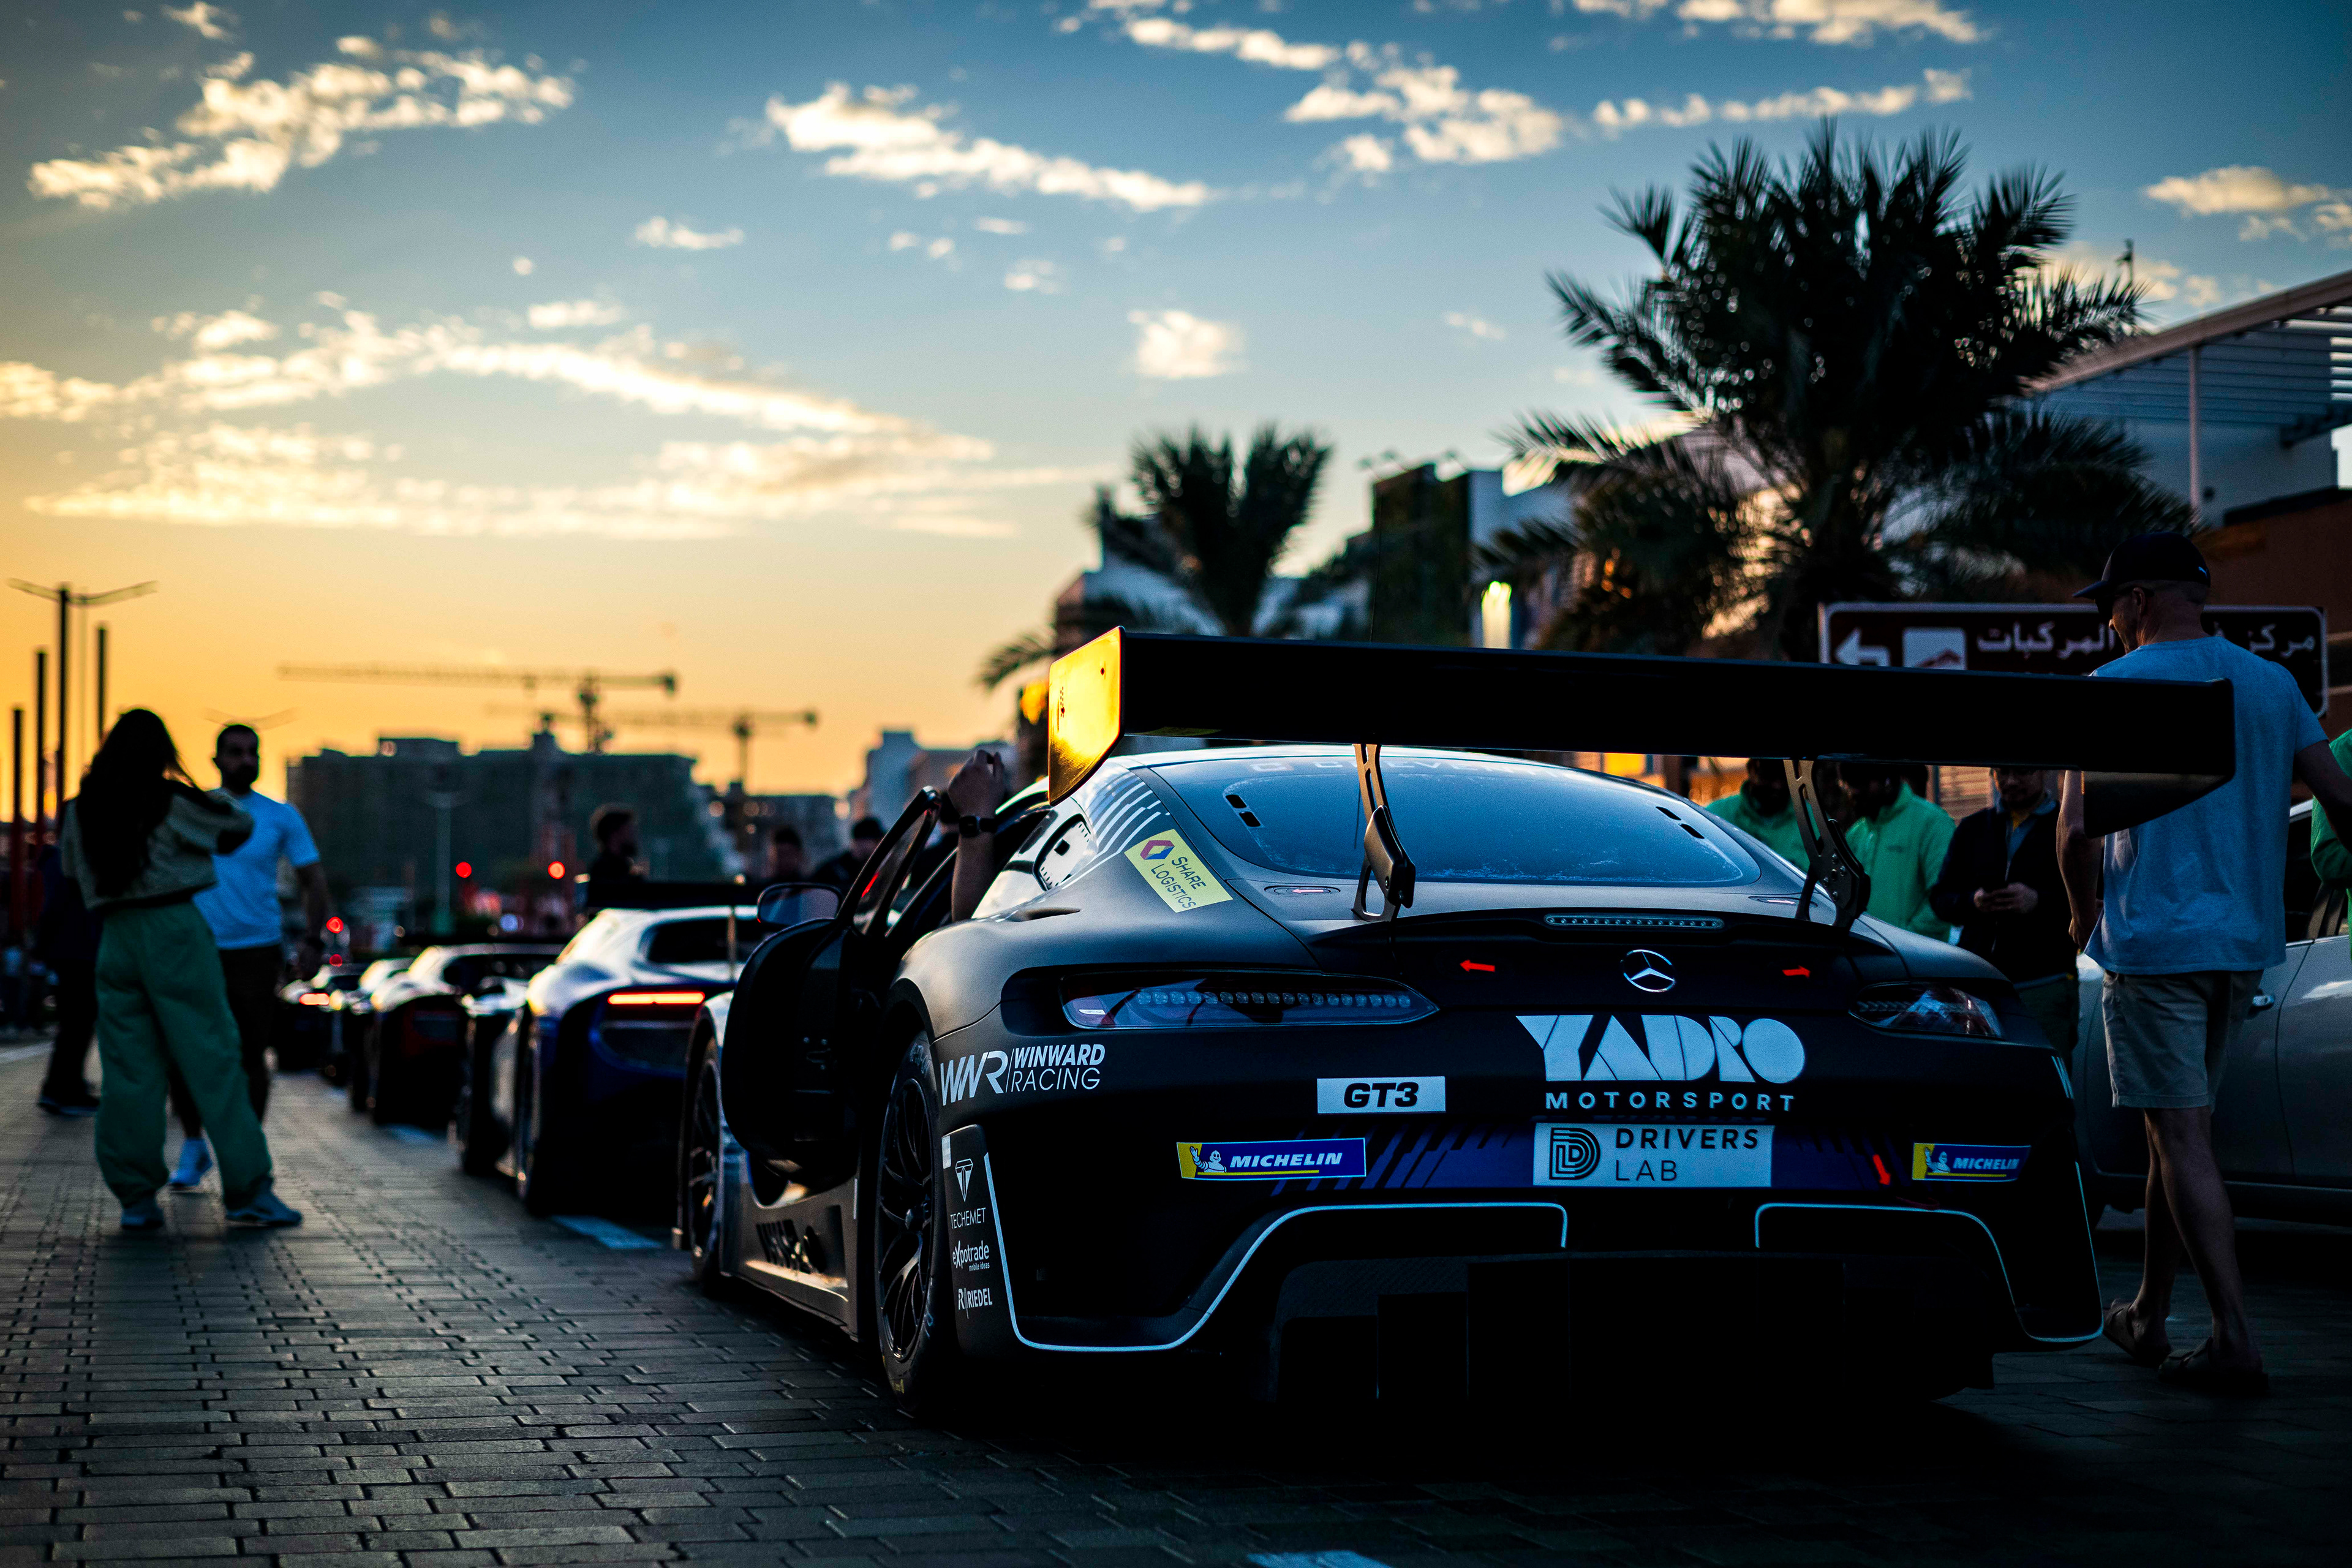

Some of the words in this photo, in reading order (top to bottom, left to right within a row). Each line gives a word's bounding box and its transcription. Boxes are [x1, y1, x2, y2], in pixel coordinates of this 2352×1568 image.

[1977, 621, 2116, 660] المركبات
[2248, 623, 2316, 660] مركز
[1171, 856, 1207, 890] SHARE
[1152, 864, 1196, 910] LOGISTICS
[1014, 1044, 1106, 1069] WINWARD
[1516, 1014, 1806, 1084] YADRO
[1011, 1067, 1101, 1093] RACING
[1344, 1082, 1419, 1108] GT3
[1545, 1091, 1795, 1112] MOTORSPORT
[1615, 1128, 1758, 1150] DRIVERS
[1229, 1152, 1343, 1169] MICHELIN
[1615, 1159, 1678, 1182] LAB
[1953, 1157, 2020, 1170] MICHELIN
[950, 1207, 986, 1229] TECHEMET
[968, 1262, 980, 1272] mobile
